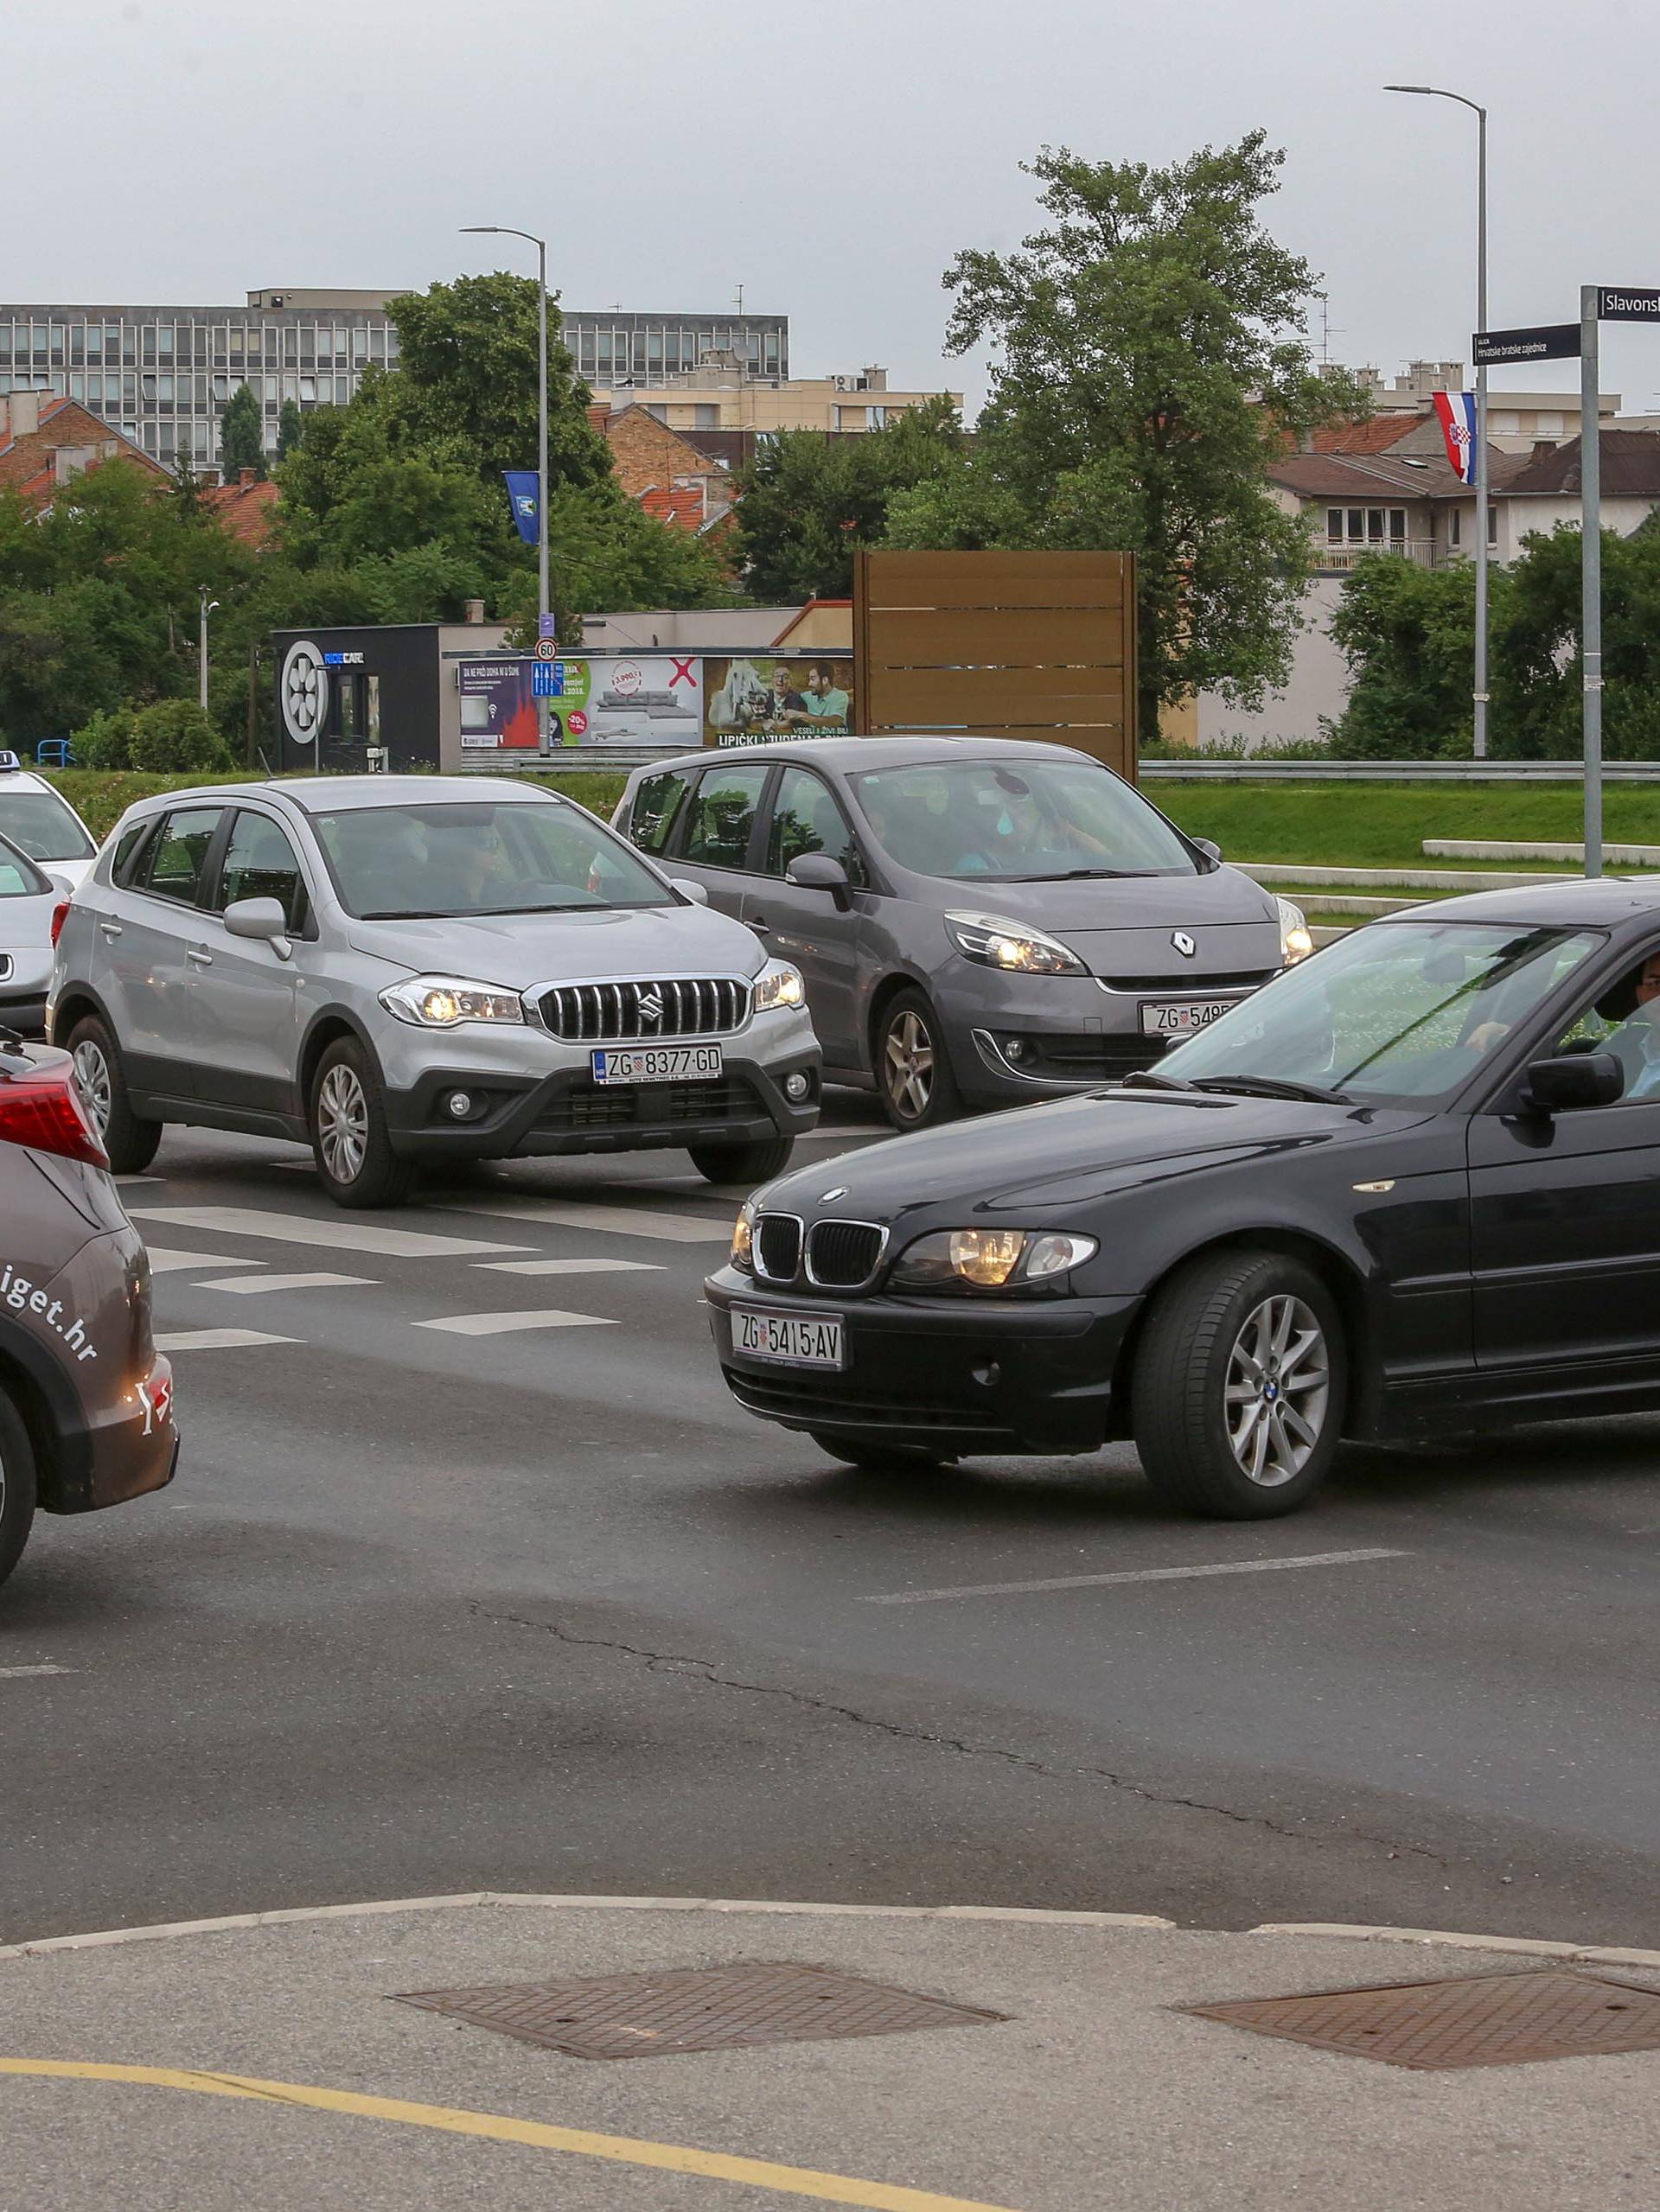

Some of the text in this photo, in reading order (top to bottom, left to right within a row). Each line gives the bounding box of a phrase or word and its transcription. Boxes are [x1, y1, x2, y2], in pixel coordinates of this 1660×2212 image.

[1606, 294, 1660, 312] Slavons
[1478, 342, 1547, 357] Hrvatske bratske zajednice
[540, 644, 553, 656] 60
[719, 733, 758, 747] LIPIČKI
[1157, 1008, 1178, 1029] ZG
[608, 1054, 632, 1076] ZG
[741, 1314, 759, 1349] ZG
